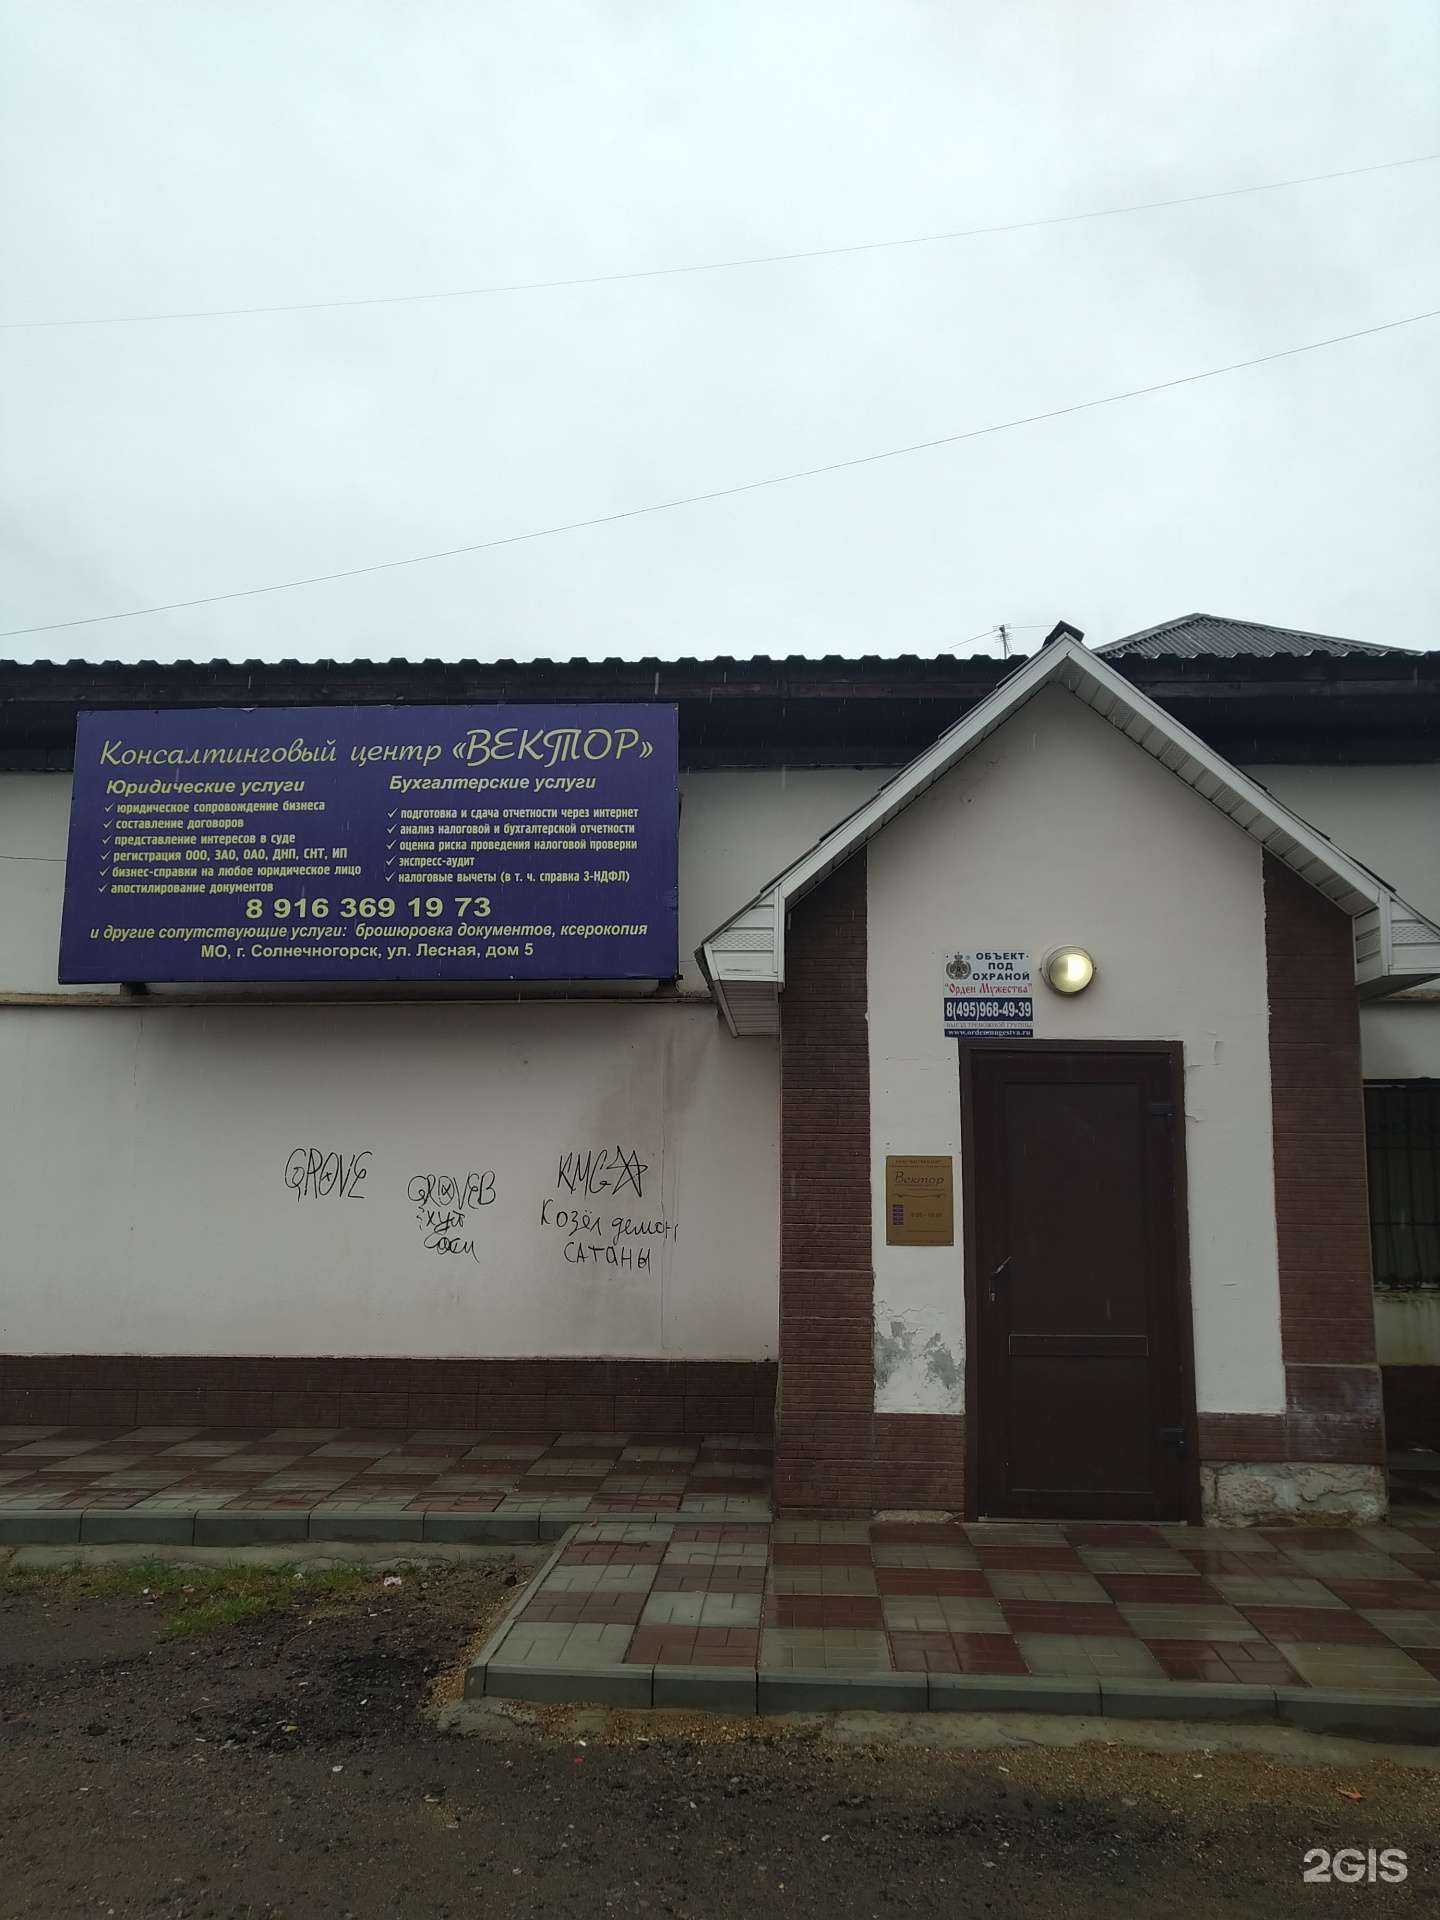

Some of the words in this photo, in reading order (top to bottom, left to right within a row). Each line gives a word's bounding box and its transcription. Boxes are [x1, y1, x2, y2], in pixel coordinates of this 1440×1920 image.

[100, 737, 337, 765] Консалтинговый
[350, 740, 442, 767] центр
[452, 727, 654, 768] «ВЕКТОР»
[107, 779, 236, 797] Юридические
[240, 779, 305, 796] услуги
[389, 775, 530, 793] Бухгалтерские
[533, 775, 597, 792] услуги
[117, 802, 189, 814] юридическое
[193, 801, 279, 813] сопровождение
[282, 799, 326, 812] бизнеса
[400, 808, 457, 820] подготовка
[461, 808, 468, 818] и
[470, 808, 500, 820] сдача
[503, 808, 558, 819] отчетности
[561, 808, 590, 820] через
[593, 807, 639, 819] интернет
[115, 818, 184, 830] составление
[187, 817, 244, 830] договоров
[400, 824, 435, 835] анализ
[438, 822, 490, 835] налоговой
[494, 824, 500, 834] и
[503, 822, 577, 836] бухгалтерской
[580, 823, 635, 834] отчетности
[114, 834, 197, 847] представление
[200, 833, 256, 846] интересов
[260, 835, 267, 844] в
[270, 834, 296, 845] суде
[399, 840, 435, 851] оценка
[438, 839, 467, 852] риска
[470, 839, 530, 851] проведения
[534, 837, 586, 850] налоговой
[589, 838, 638, 851] проверки
[113, 851, 181, 863] регистрация
[185, 850, 211, 862] ООО,
[214, 849, 239, 861] ЗАО,
[243, 849, 268, 861] ОАО,
[272, 848, 299, 861] ДНП,
[303, 847, 328, 860] СНТ,
[332, 847, 348, 859] ИП
[398, 855, 475, 868] экспресс-аудит
[112, 866, 197, 878] бизнес-справки
[201, 867, 214, 877] на
[217, 866, 253, 877] любое
[257, 865, 330, 878] юридическое
[334, 865, 362, 876] лицо
[398, 872, 453, 883] налоговые
[456, 871, 497, 883] вычеты
[500, 871, 512, 884] (в
[514, 872, 523, 882] т.
[526, 872, 536, 882] ч.
[539, 871, 580, 883] справка
[583, 870, 630, 884] 3-НДФЛ)
[110, 882, 206, 895] апостилирование
[209, 881, 274, 895] документов
[245, 898, 264, 919] 8
[273, 898, 329, 918] 916
[340, 897, 396, 918] 369
[407, 897, 443, 918] 19
[455, 897, 492, 918] 73
[90, 928, 100, 939] и
[103, 924, 155, 942] другие
[158, 925, 288, 940] сопутствующие
[290, 924, 348, 939] услуги:
[356, 923, 453, 940] брошюровка
[457, 922, 556, 938] документов,
[560, 923, 648, 939] ксерокопия
[201, 944, 231, 960] МО,
[237, 946, 246, 958] г.
[251, 944, 382, 960] Солнечногорск,
[387, 945, 411, 959] ул.
[416, 943, 481, 958] Лесная,
[485, 944, 519, 959] дом
[524, 943, 534, 956] 5
[976, 952, 1025, 960] ОБЪЕКТ
[988, 962, 1014, 971] ПОД
[972, 971, 1030, 981] ОХРАНОЙ
[946, 1001, 1031, 1020] 8(495)968-49-39
